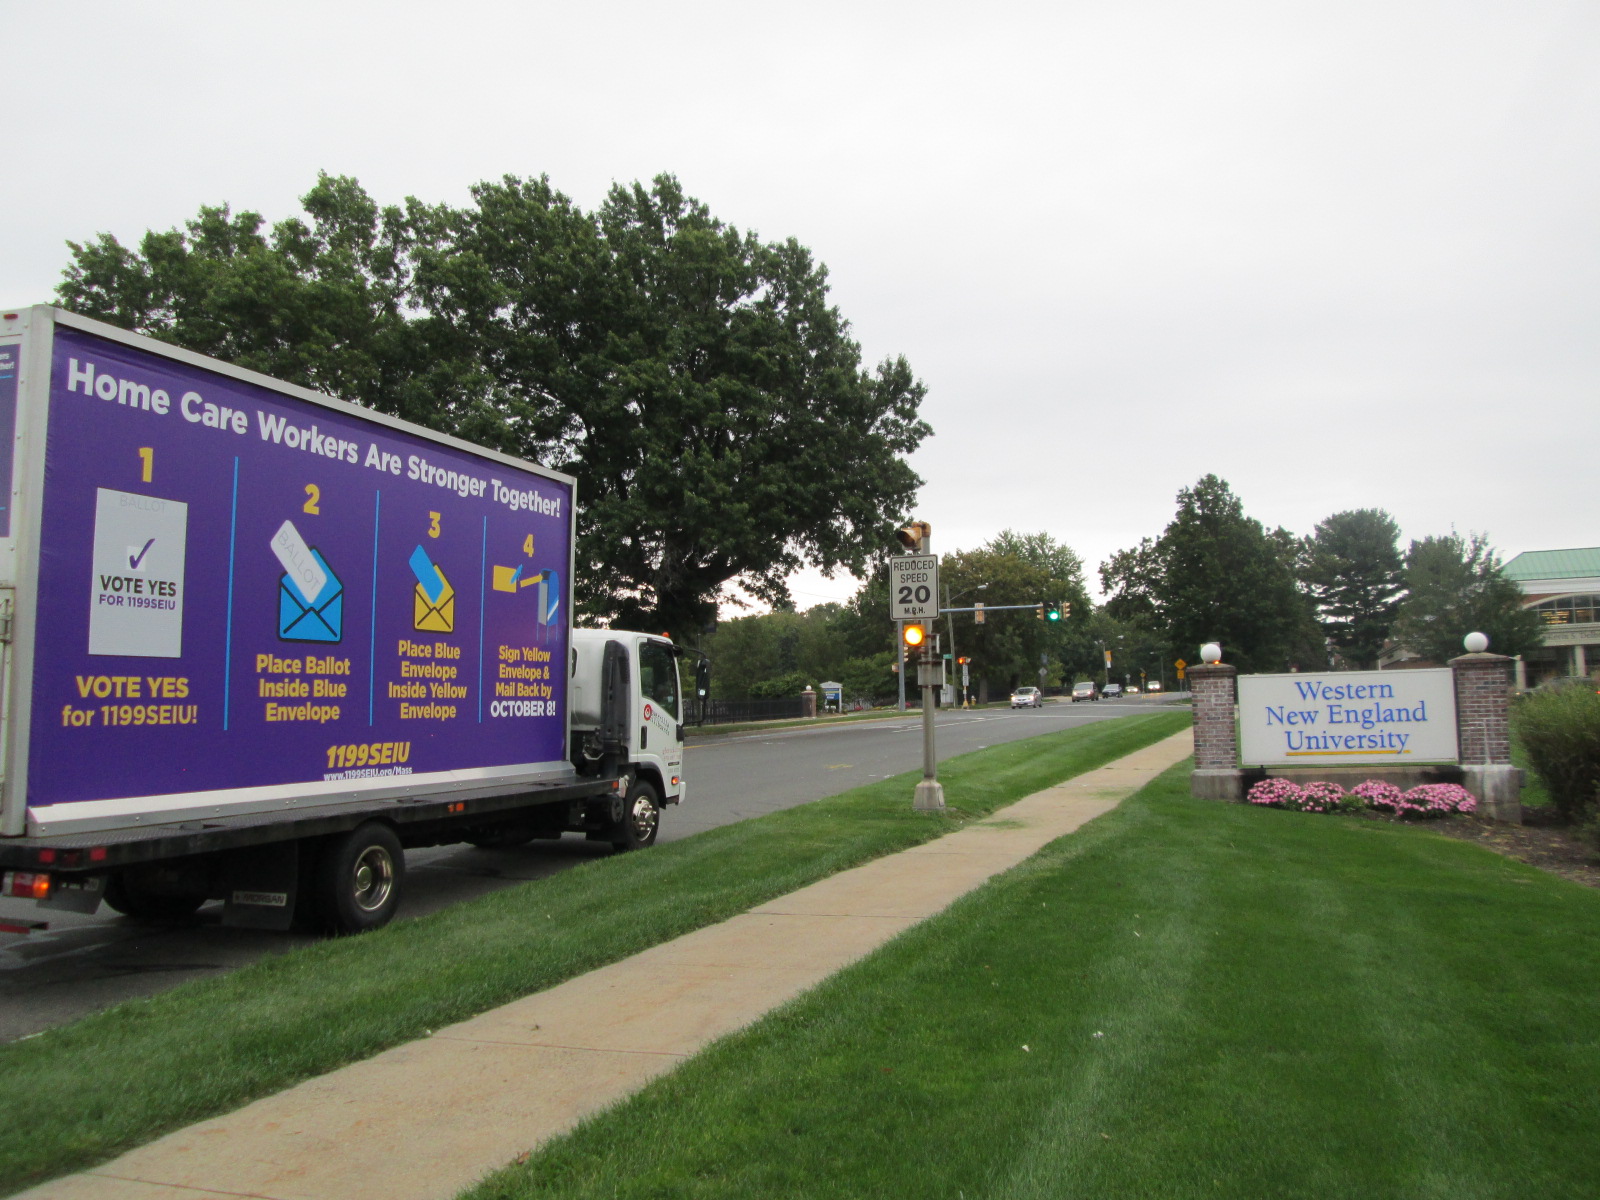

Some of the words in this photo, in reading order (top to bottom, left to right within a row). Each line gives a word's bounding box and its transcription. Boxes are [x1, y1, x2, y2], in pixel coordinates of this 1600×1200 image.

[68, 357, 170, 415] Home
[181, 391, 248, 435] Care
[257, 410, 359, 464] Workers
[364, 443, 402, 475] Are
[407, 455, 487, 498] Stronger
[491, 479, 561, 518] Together!
[139, 447, 153, 483] 1
[303, 483, 320, 515] 2
[428, 511, 441, 539] 3
[523, 534, 534, 558] 4
[278, 530, 320, 590] BALLOT
[893, 560, 935, 571] REDUCED
[100, 574, 143, 594] VOTE
[148, 579, 177, 597] YES
[900, 573, 928, 583] SPEED
[99, 594, 124, 606] FOR
[127, 596, 176, 610] 1199SEIU
[898, 585, 931, 604] 20
[398, 639, 432, 658] Place
[435, 642, 460, 659] Blue
[499, 645, 520, 663] Sign
[522, 647, 551, 662] Yellow
[256, 653, 302, 674] Place
[305, 656, 351, 675] Ballot
[401, 661, 457, 681] Envelope
[499, 664, 541, 682] Envelope
[543, 666, 549, 680] &
[76, 675, 142, 698] VOTE
[147, 676, 189, 698] YES
[259, 678, 310, 697] Inside
[313, 679, 347, 697] Blue
[388, 681, 427, 698] Inside
[429, 682, 467, 698] Yellow
[495, 682, 515, 697] Mail
[517, 682, 539, 697] Back
[541, 682, 552, 700] by
[1295, 681, 1395, 701] Western
[62, 704, 95, 727] for
[101, 704, 198, 726] 1199SEIU!
[265, 701, 340, 724] Envelope
[400, 702, 456, 721] Envelope
[490, 700, 544, 718] OCTOBER
[546, 701, 556, 716] 8!
[1265, 706, 1319, 726] New
[1326, 700, 1428, 730] England
[1284, 729, 1410, 754] University
[326, 742, 411, 768] 1199SEIU
[323, 766, 413, 782] www.1199SEIU.org/Mass
